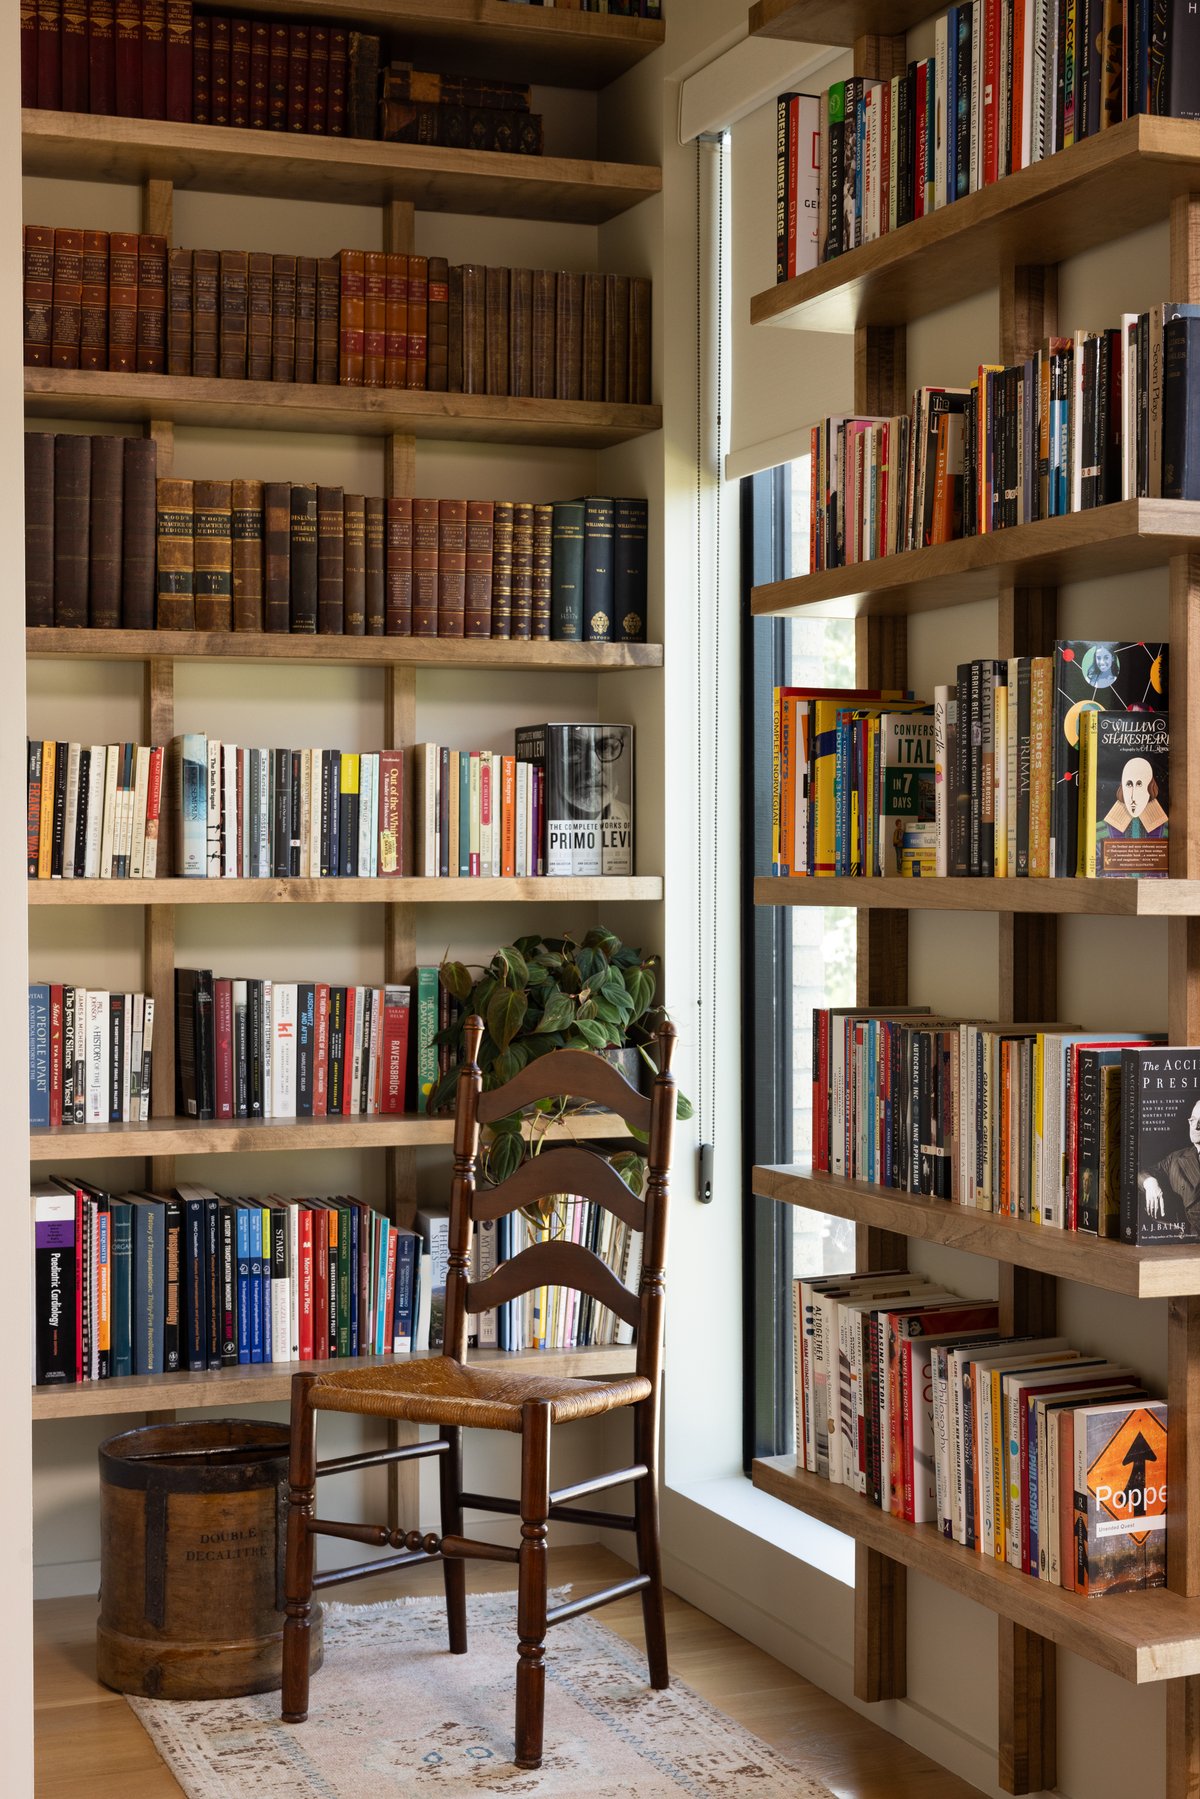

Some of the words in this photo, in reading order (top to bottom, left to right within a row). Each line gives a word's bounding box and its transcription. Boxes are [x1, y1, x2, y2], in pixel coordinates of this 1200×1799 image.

[846, 83, 854, 112] POLIO
[1065, 57, 1074, 110] HOLES
[778, 103, 786, 154] SCIENCE
[777, 158, 785, 198] UNDER
[777, 201, 785, 237] SIEGE
[1152, 344, 1161, 383] Seven
[1151, 387, 1160, 422] Plays
[982, 669, 991, 744] EXECUTION
[1112, 719, 1156, 732] WILLIAM
[390, 769, 398, 784] Out
[1020, 736, 1030, 795] PRIMAL
[210, 788, 218, 810] Brigade
[390, 787, 398, 795] of
[893, 779, 901, 789] IN
[903, 774, 913, 793] 7
[28, 783, 41, 831] FRANCI'S
[390, 797, 398, 810] the
[893, 797, 912, 808] DAYS
[28, 836, 38, 858] WAR
[551, 832, 595, 849] PRIMO
[602, 831, 631, 848] LEVI
[37, 1006, 46, 1014] A
[37, 1016, 46, 1056] PEOPLE
[66, 1027, 73, 1039] Of
[278, 1023, 292, 1037] kl
[37, 1059, 46, 1093] APART
[94, 1063, 100, 1071] OF
[389, 1041, 400, 1095] RAVENSBRÜCK
[428, 1072, 433, 1081] OF
[1143, 1061, 1159, 1071] The
[1164, 1059, 1200, 1071] ACCI
[1083, 1059, 1092, 1160] RUSSELL
[1157, 1222, 1185, 1231] BAIME
[50, 1253, 61, 1287] Paediatric
[167, 1227, 179, 1280] Transplantation
[439, 1235, 447, 1284] HERITAGE
[49, 1290, 61, 1326] Cardiology
[167, 1283, 179, 1325] Immunology
[938, 1382, 947, 1453] Philosophy
[1029, 1456, 1037, 1534] PHILOSOPHY
[200, 1528, 256, 1544] DOUBLE
